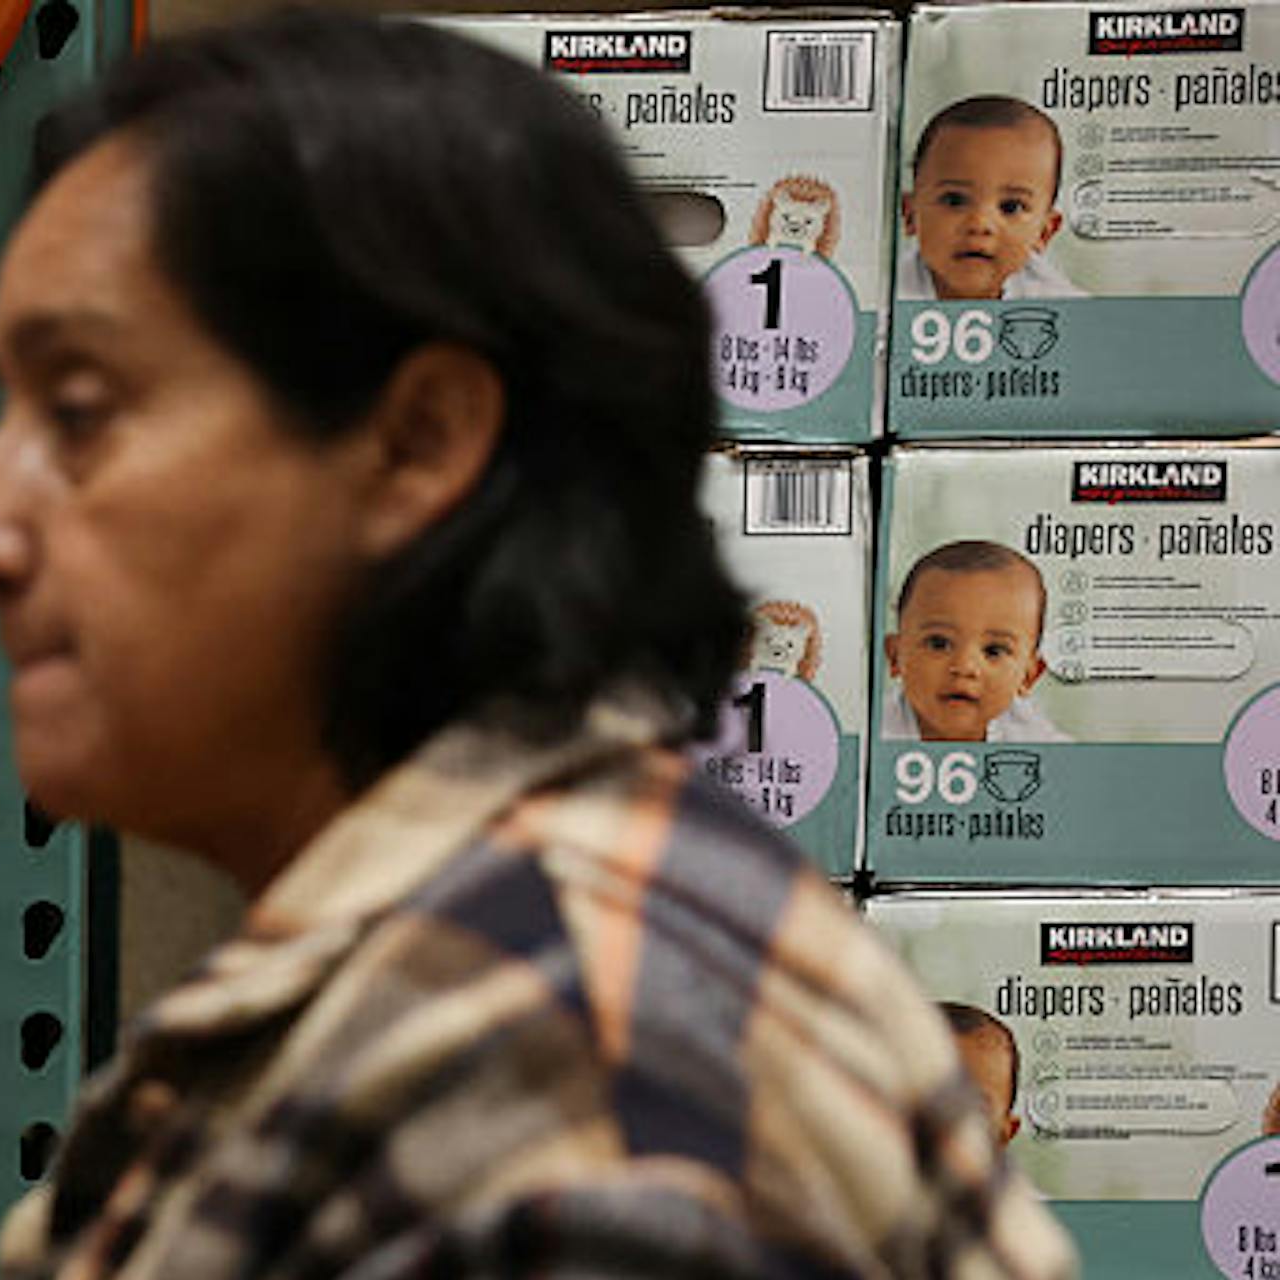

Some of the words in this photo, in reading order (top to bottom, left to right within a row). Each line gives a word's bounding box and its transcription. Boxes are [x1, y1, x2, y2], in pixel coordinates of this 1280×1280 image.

[551, 35, 687, 57] KIRKLAND
[1097, 13, 1238, 39] KIRKLAND
[627, 83, 736, 129] pañales
[1044, 67, 1150, 112] diapers
[748, 259, 783, 330] 1
[736, 336, 760, 362] lbs
[774, 337, 792, 362] 14
[797, 337, 820, 364] lbs
[910, 308, 995, 366] 96
[1080, 463, 1223, 487] KIRKLAND
[1026, 514, 1136, 559] diapers
[1159, 515, 1275, 560] pañales
[733, 683, 766, 753] 1
[896, 751, 980, 804] 96
[886, 811, 958, 843] diapers
[1266, 798, 1277, 826] 4
[1049, 926, 1189, 950] KIRKLAND
[997, 976, 1105, 1020] diapers
[1129, 976, 1243, 1020] pañales
